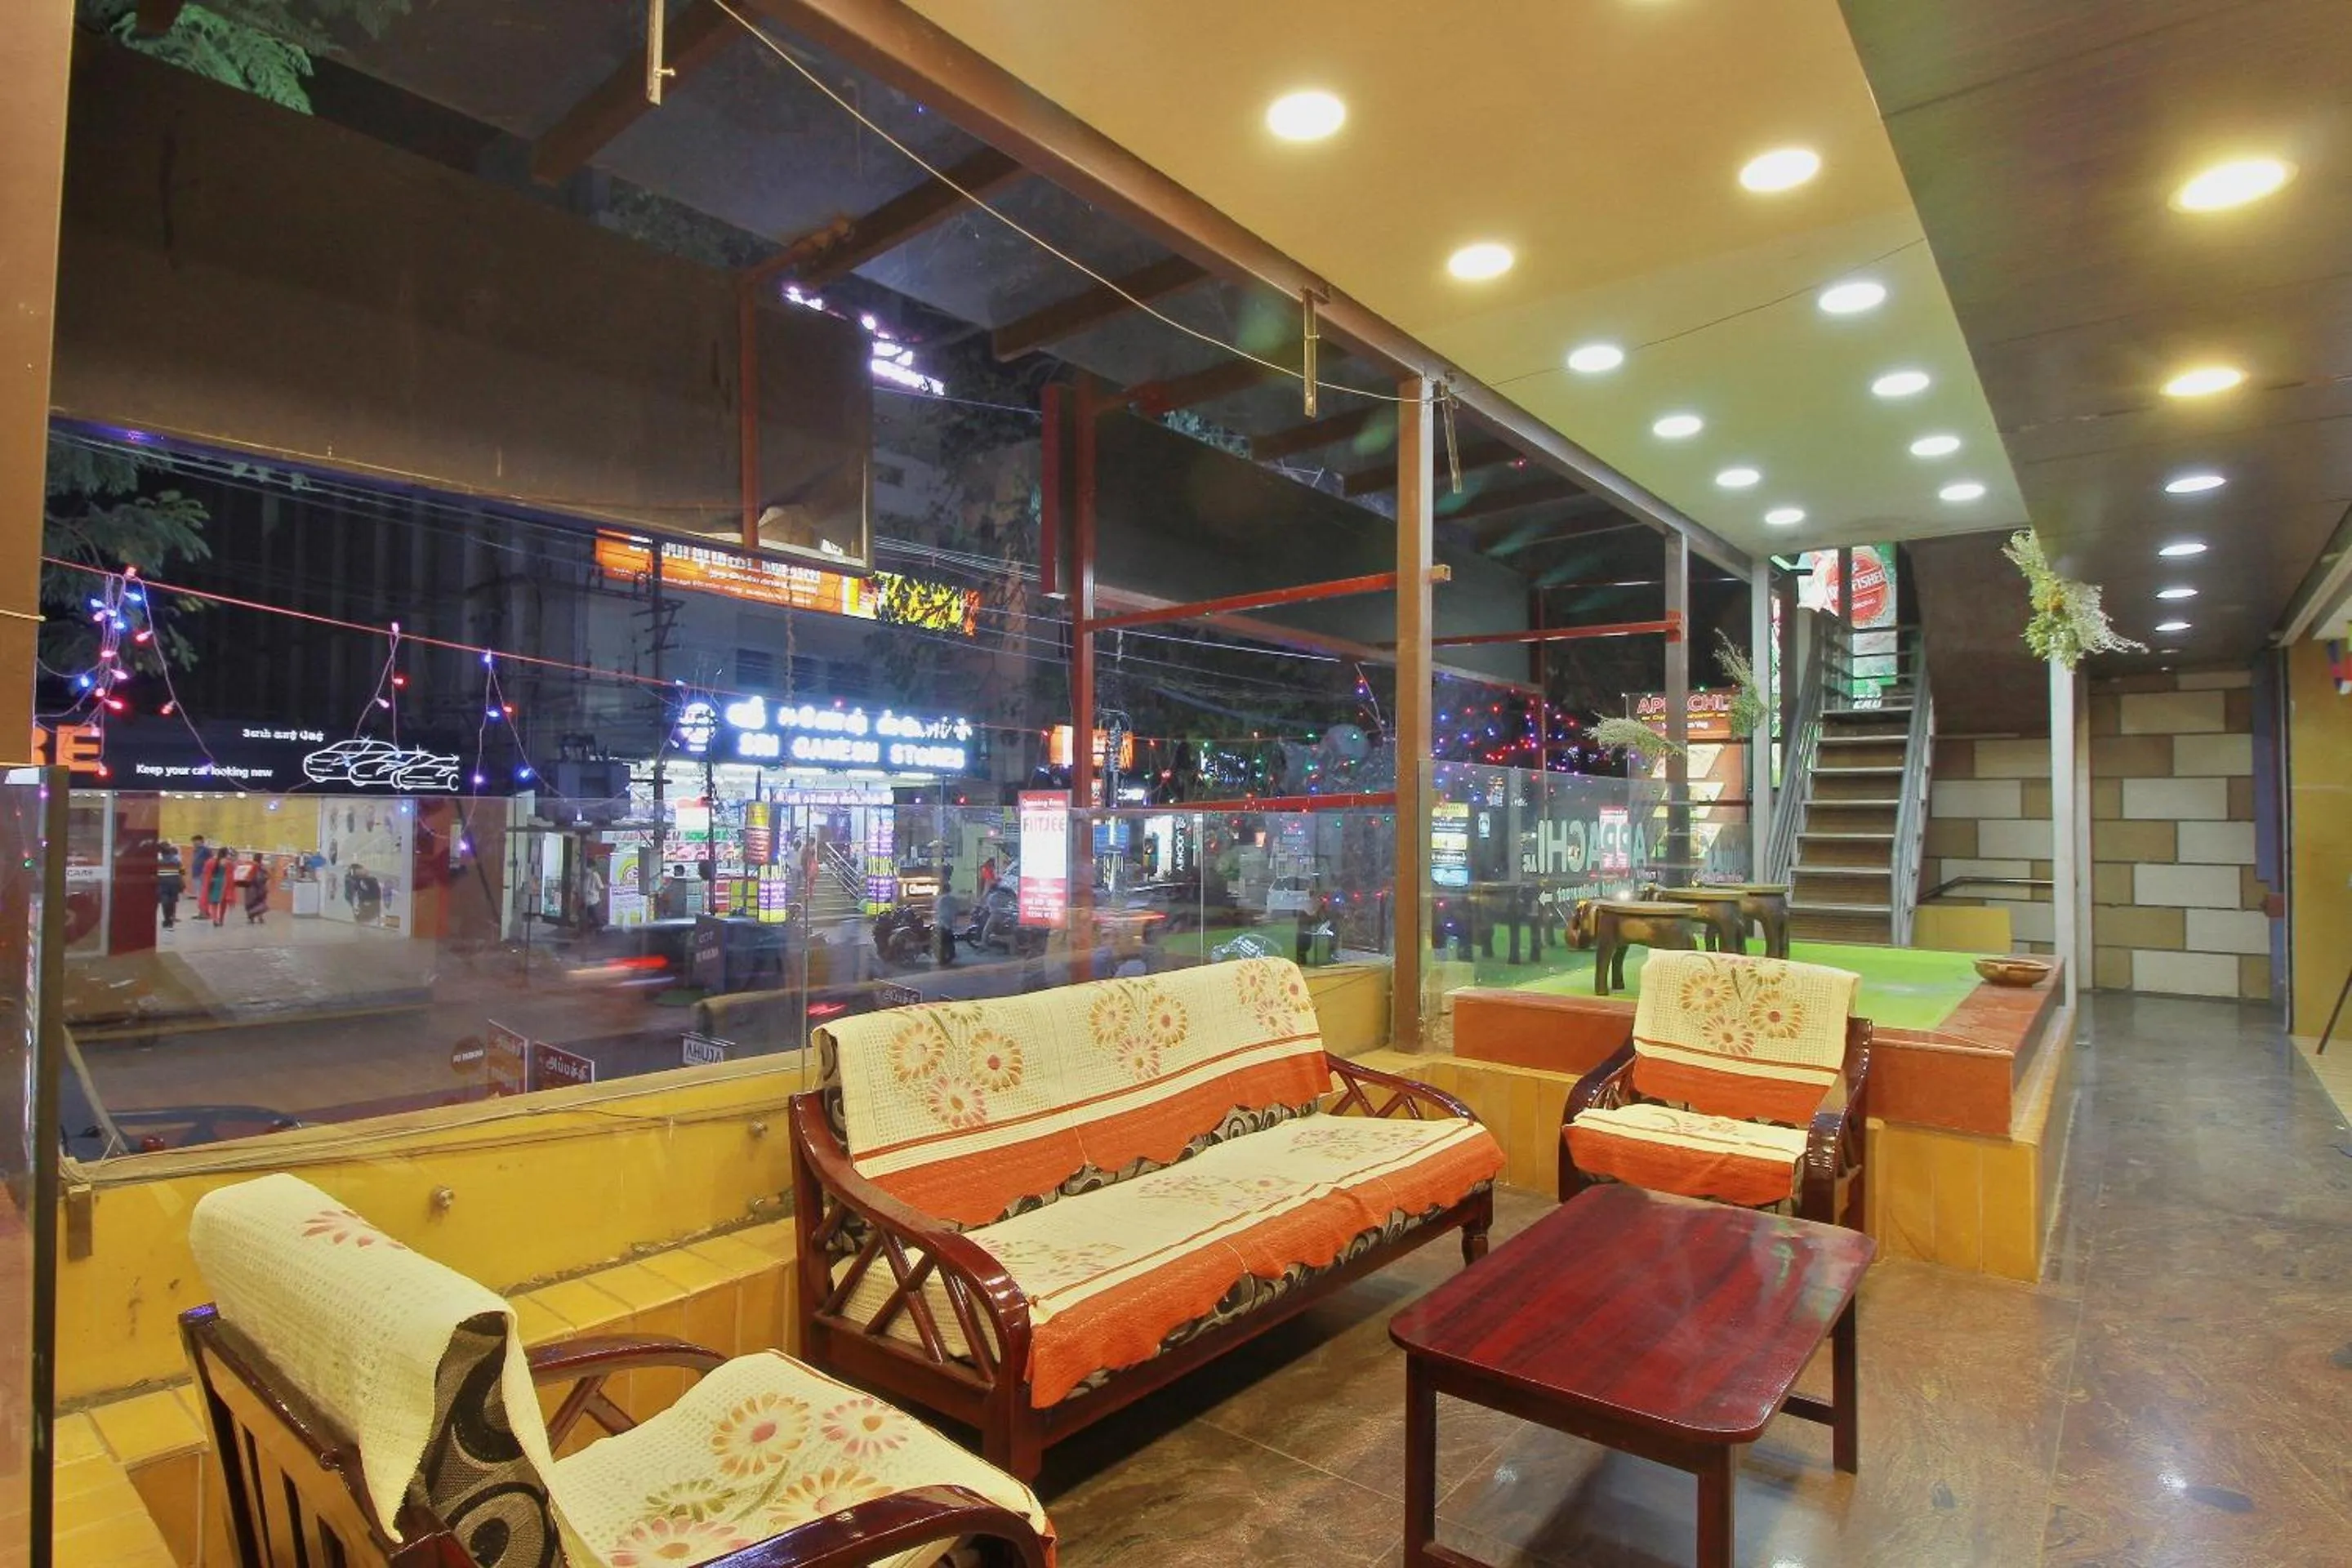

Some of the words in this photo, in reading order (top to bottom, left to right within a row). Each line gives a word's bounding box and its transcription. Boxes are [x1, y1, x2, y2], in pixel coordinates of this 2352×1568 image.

[1636, 694, 1723, 713] APCHI
[791, 736, 879, 763] GANESH
[136, 764, 163, 777] Keep
[166, 766, 190, 777] your
[192, 767, 208, 776] car
[212, 766, 248, 778] looking
[251, 768, 273, 777] new
[1022, 817, 1065, 833] FIITJEE
